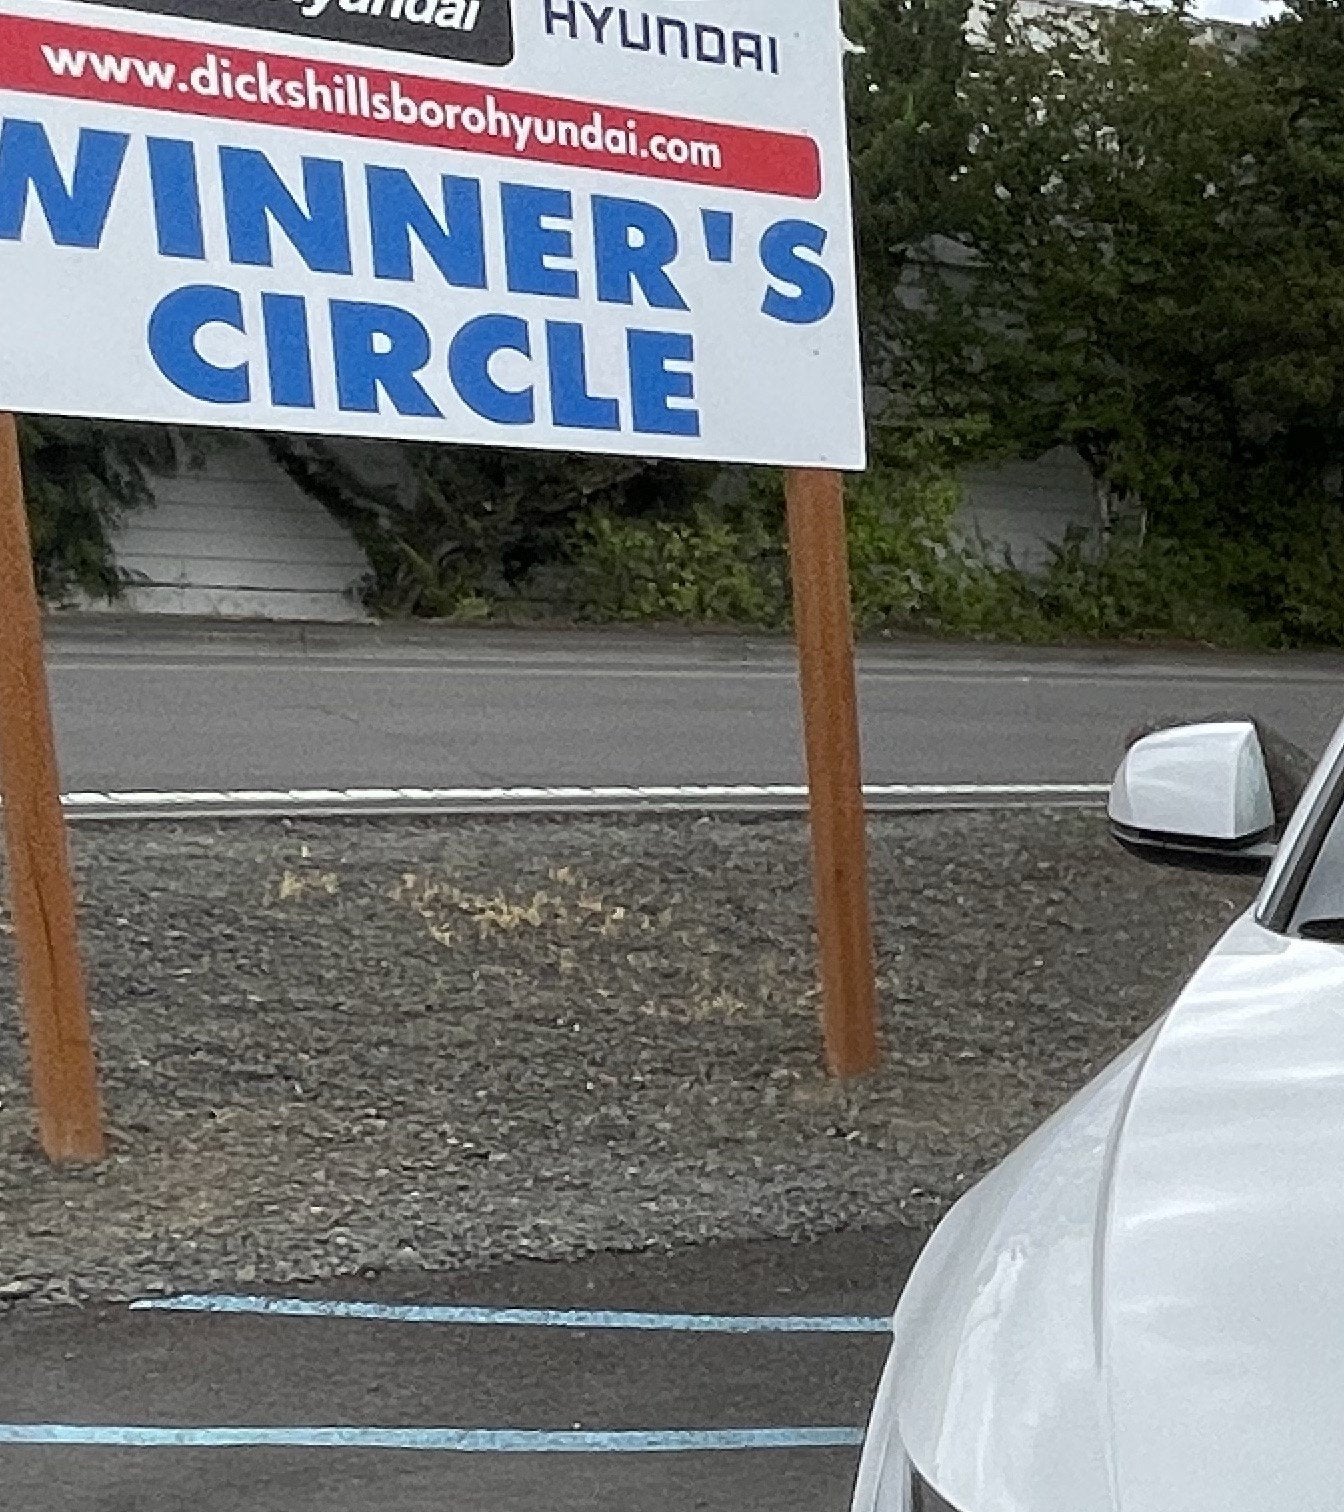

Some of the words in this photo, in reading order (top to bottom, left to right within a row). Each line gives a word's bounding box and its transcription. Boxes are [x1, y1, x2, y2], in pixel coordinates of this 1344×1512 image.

[288, 0, 480, 31] ndai
[544, 0, 779, 76] HYUNDAI
[40, 43, 723, 169] www.dickshillsborohyundai.com
[0, 118, 835, 324] WINNER'S
[148, 284, 701, 437] CIRCLE
